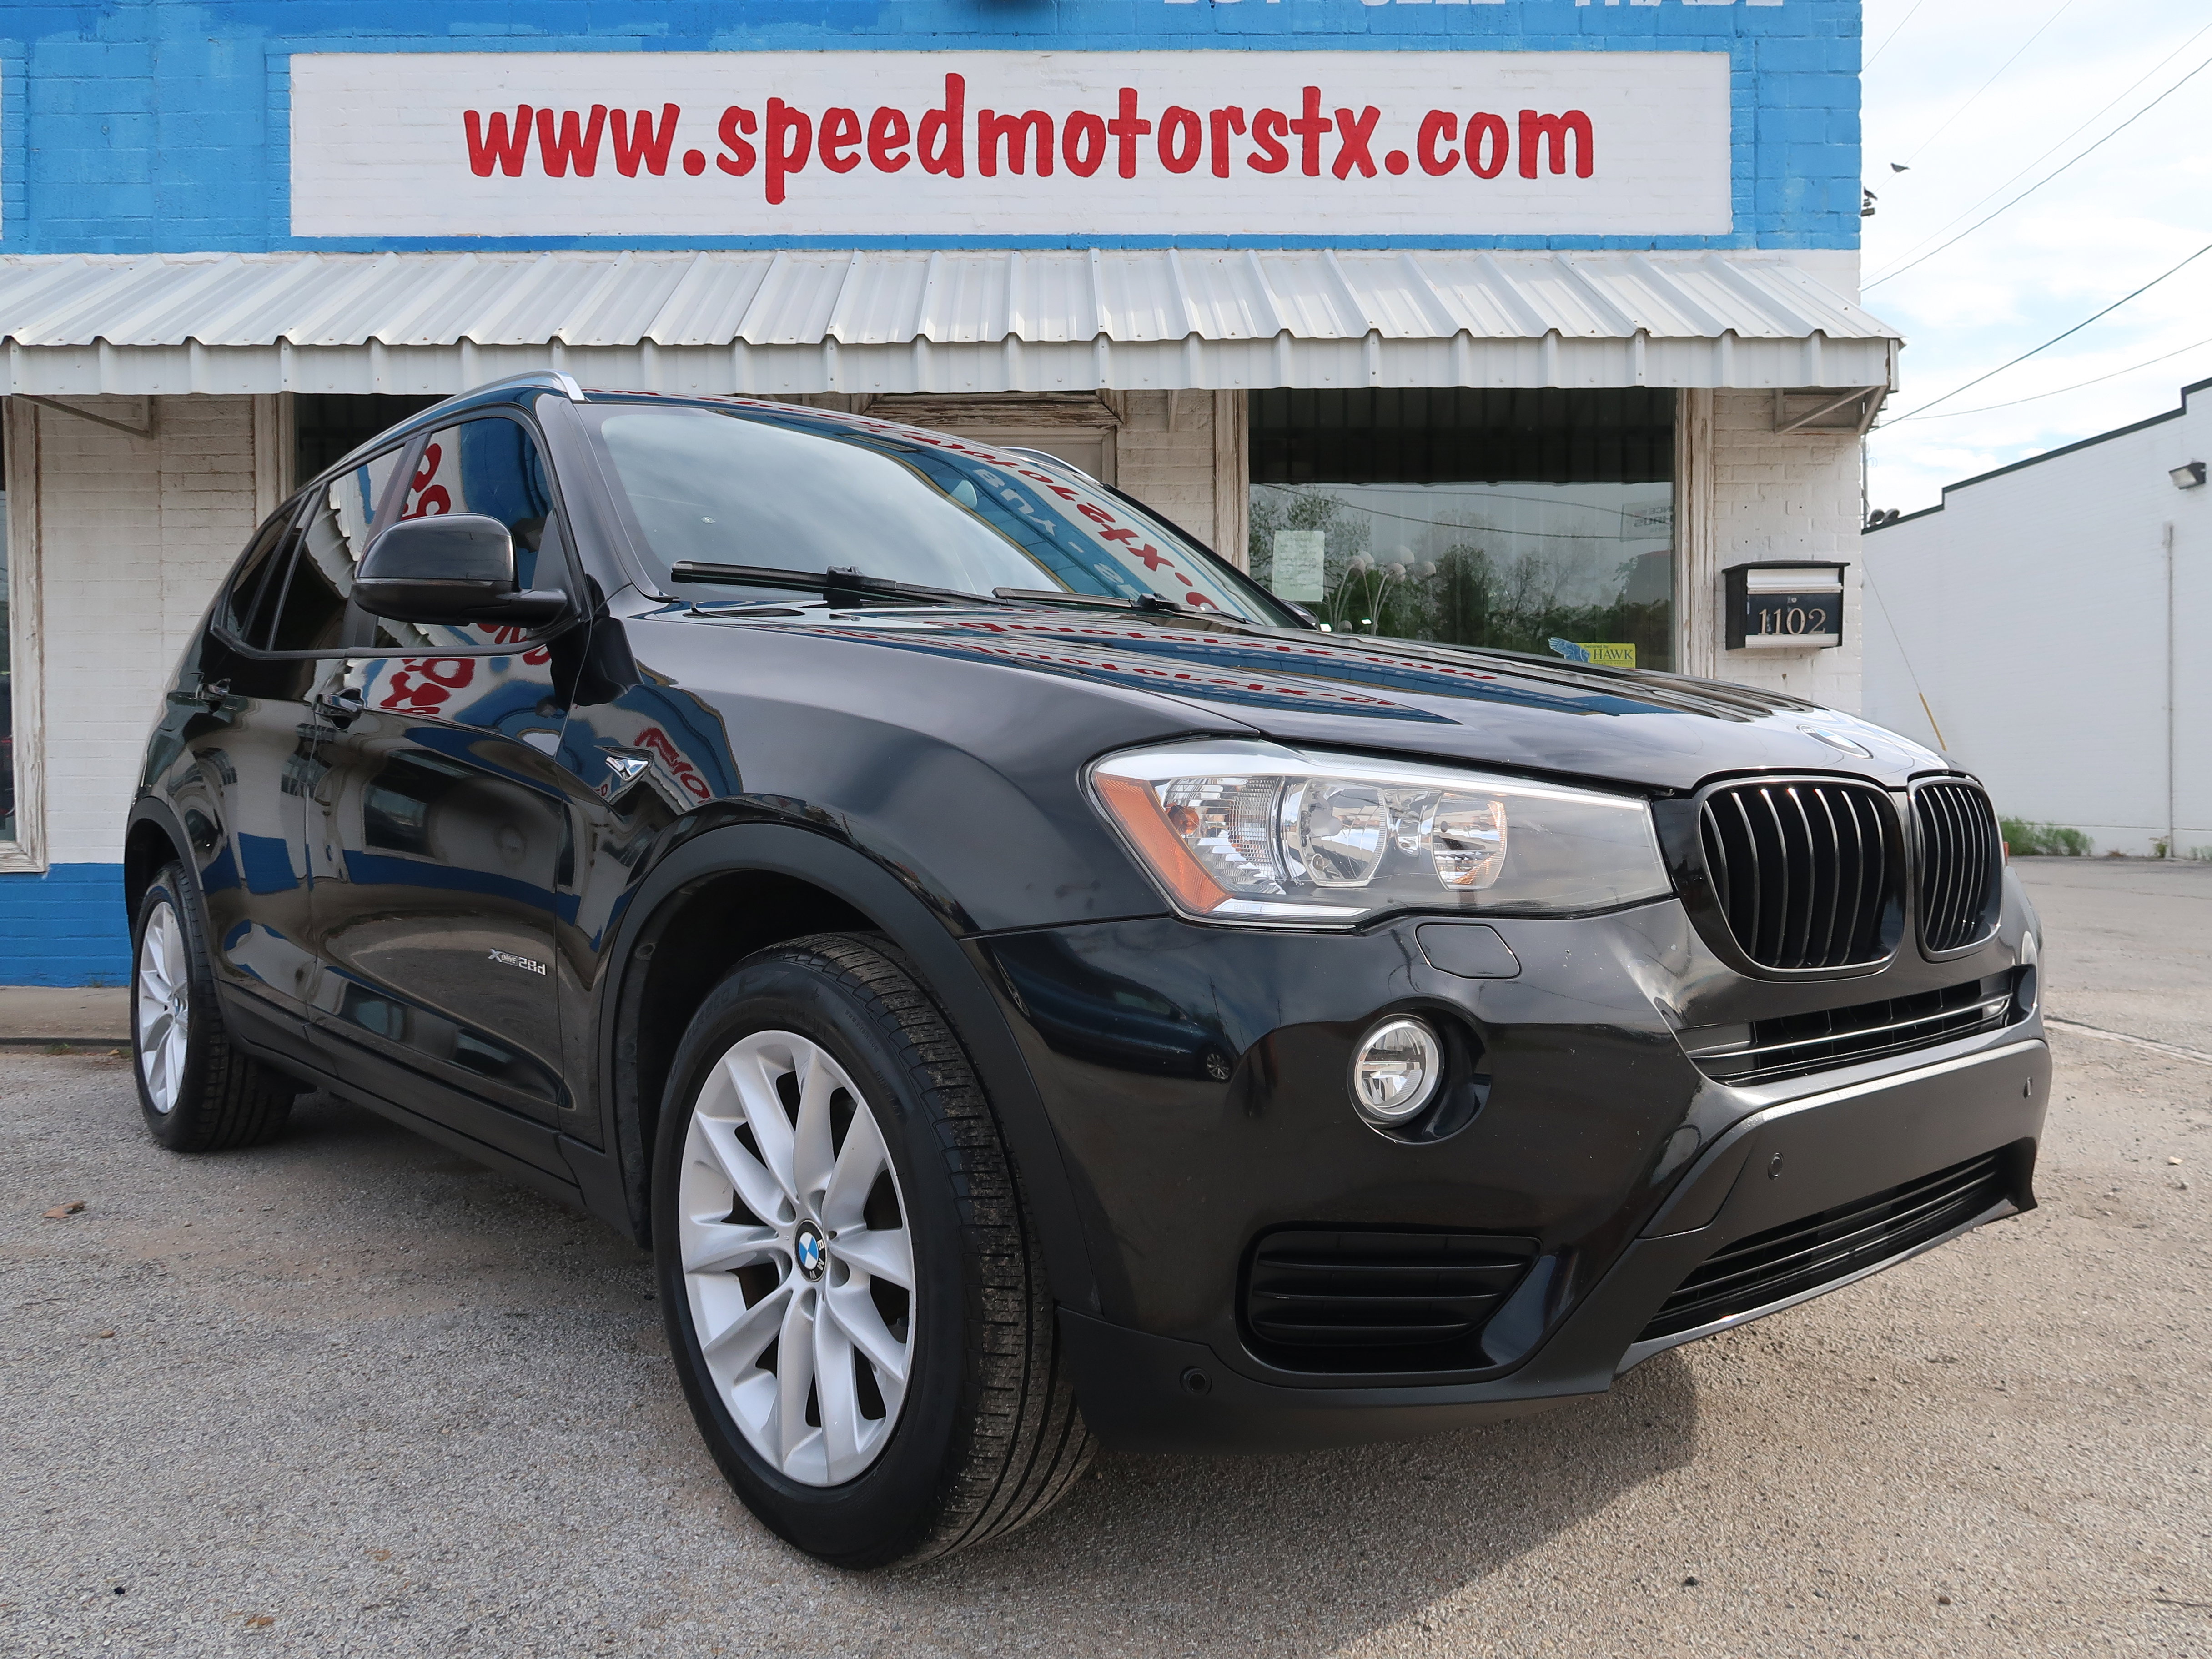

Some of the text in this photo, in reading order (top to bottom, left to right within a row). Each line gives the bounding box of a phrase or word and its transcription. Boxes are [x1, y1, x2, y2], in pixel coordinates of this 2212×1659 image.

[464, 73, 1593, 204] www.speedmotorstx.com
[1758, 608, 1826, 635] 1102
[1594, 649, 1634, 659] HAWK
[809, 1239, 825, 1279] BMW
